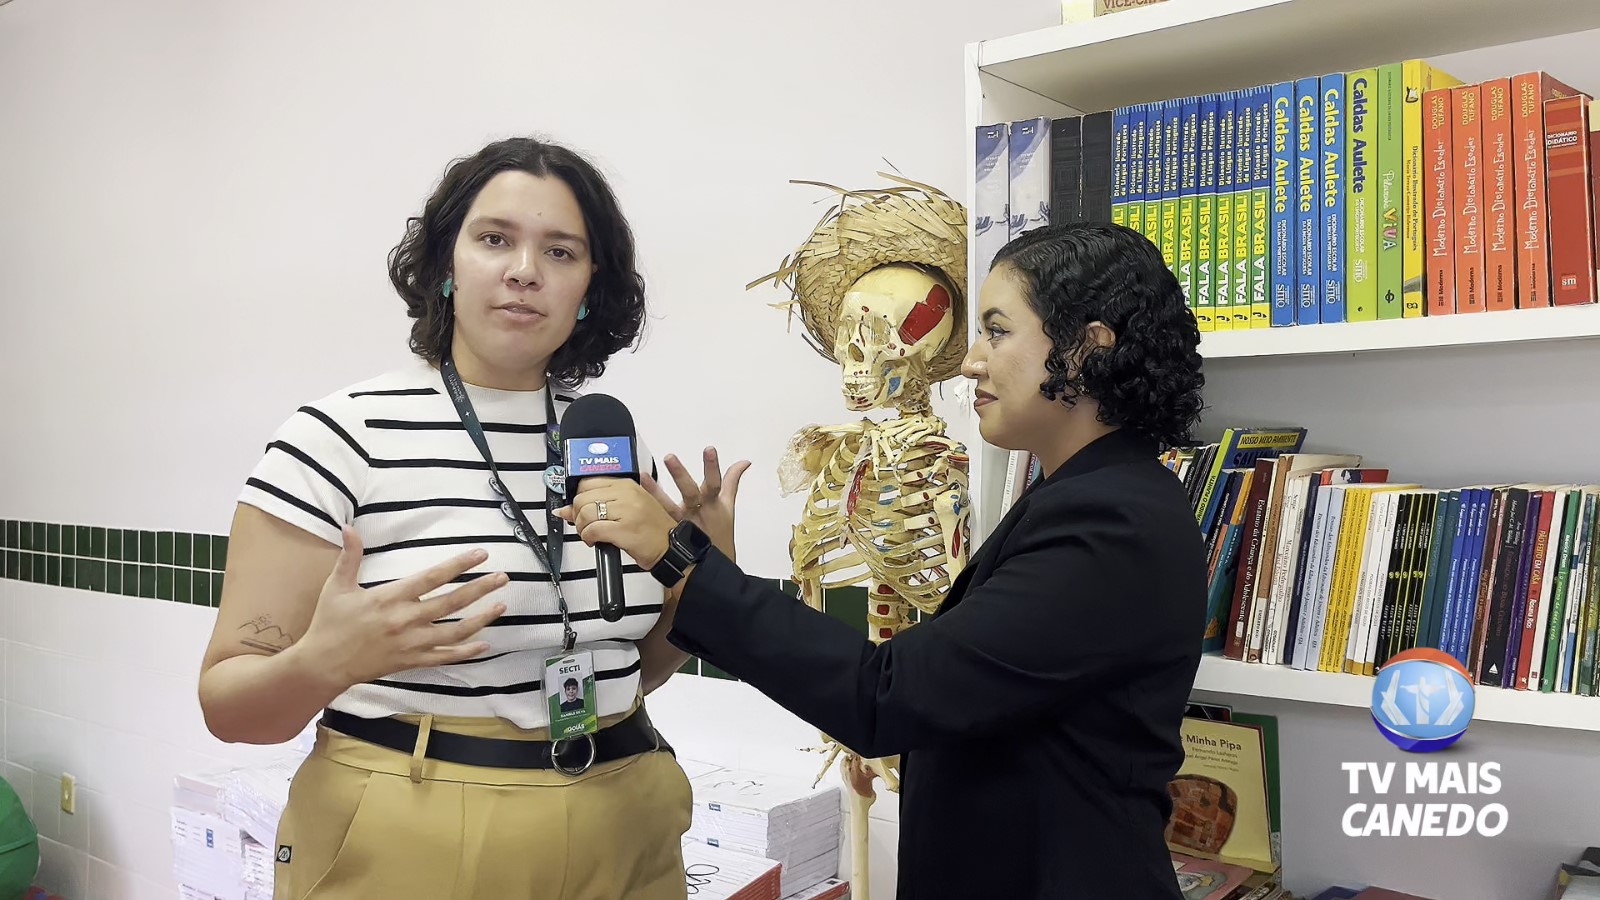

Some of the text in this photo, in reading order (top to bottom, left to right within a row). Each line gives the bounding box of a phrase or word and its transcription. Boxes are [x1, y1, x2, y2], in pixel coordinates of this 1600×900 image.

[1325, 88, 1339, 207] Caldas Aulete
[1353, 78, 1367, 193] Caldas Aulete
[1493, 133, 1504, 163] Escolar
[1524, 129, 1536, 160] Escolar
[1547, 136, 1578, 146] DIDÁTICO
[1275, 97, 1289, 213] Caldas Aulete
[1300, 95, 1315, 212] Caldas Aulete
[1433, 141, 1445, 171] Escolar
[1464, 137, 1476, 168] Escolar
[1147, 205, 1157, 241] ASIL!
[1165, 202, 1174, 263] BRASIL!
[1182, 199, 1191, 260] BRASIL!
[1433, 219, 1447, 256] Moderno
[1463, 216, 1478, 254] Moderno
[1492, 213, 1506, 251] Moderno
[1524, 211, 1539, 249] Moderno
[1199, 198, 1211, 305] FALA BRASIL!
[1218, 198, 1229, 305] FALA BRASIL!
[1236, 195, 1247, 304] FALA BRASIL!
[1254, 191, 1265, 301] FALA BRASIL!
[1561, 278, 1577, 286] sm
[1254, 499, 1265, 528] Estatuto
[1253, 528, 1260, 537] da
[1537, 531, 1547, 542] PÃO
[1247, 538, 1259, 565] Criança
[1535, 560, 1542, 569] EM
[1536, 543, 1544, 559] FEITO
[1245, 571, 1253, 580] do
[1532, 570, 1541, 585] CASA
[1238, 581, 1251, 621] Adolescente
[1527, 599, 1537, 617] Rosana
[558, 664, 581, 674] SECTI
[1186, 734, 1242, 751] Minha Pipa
